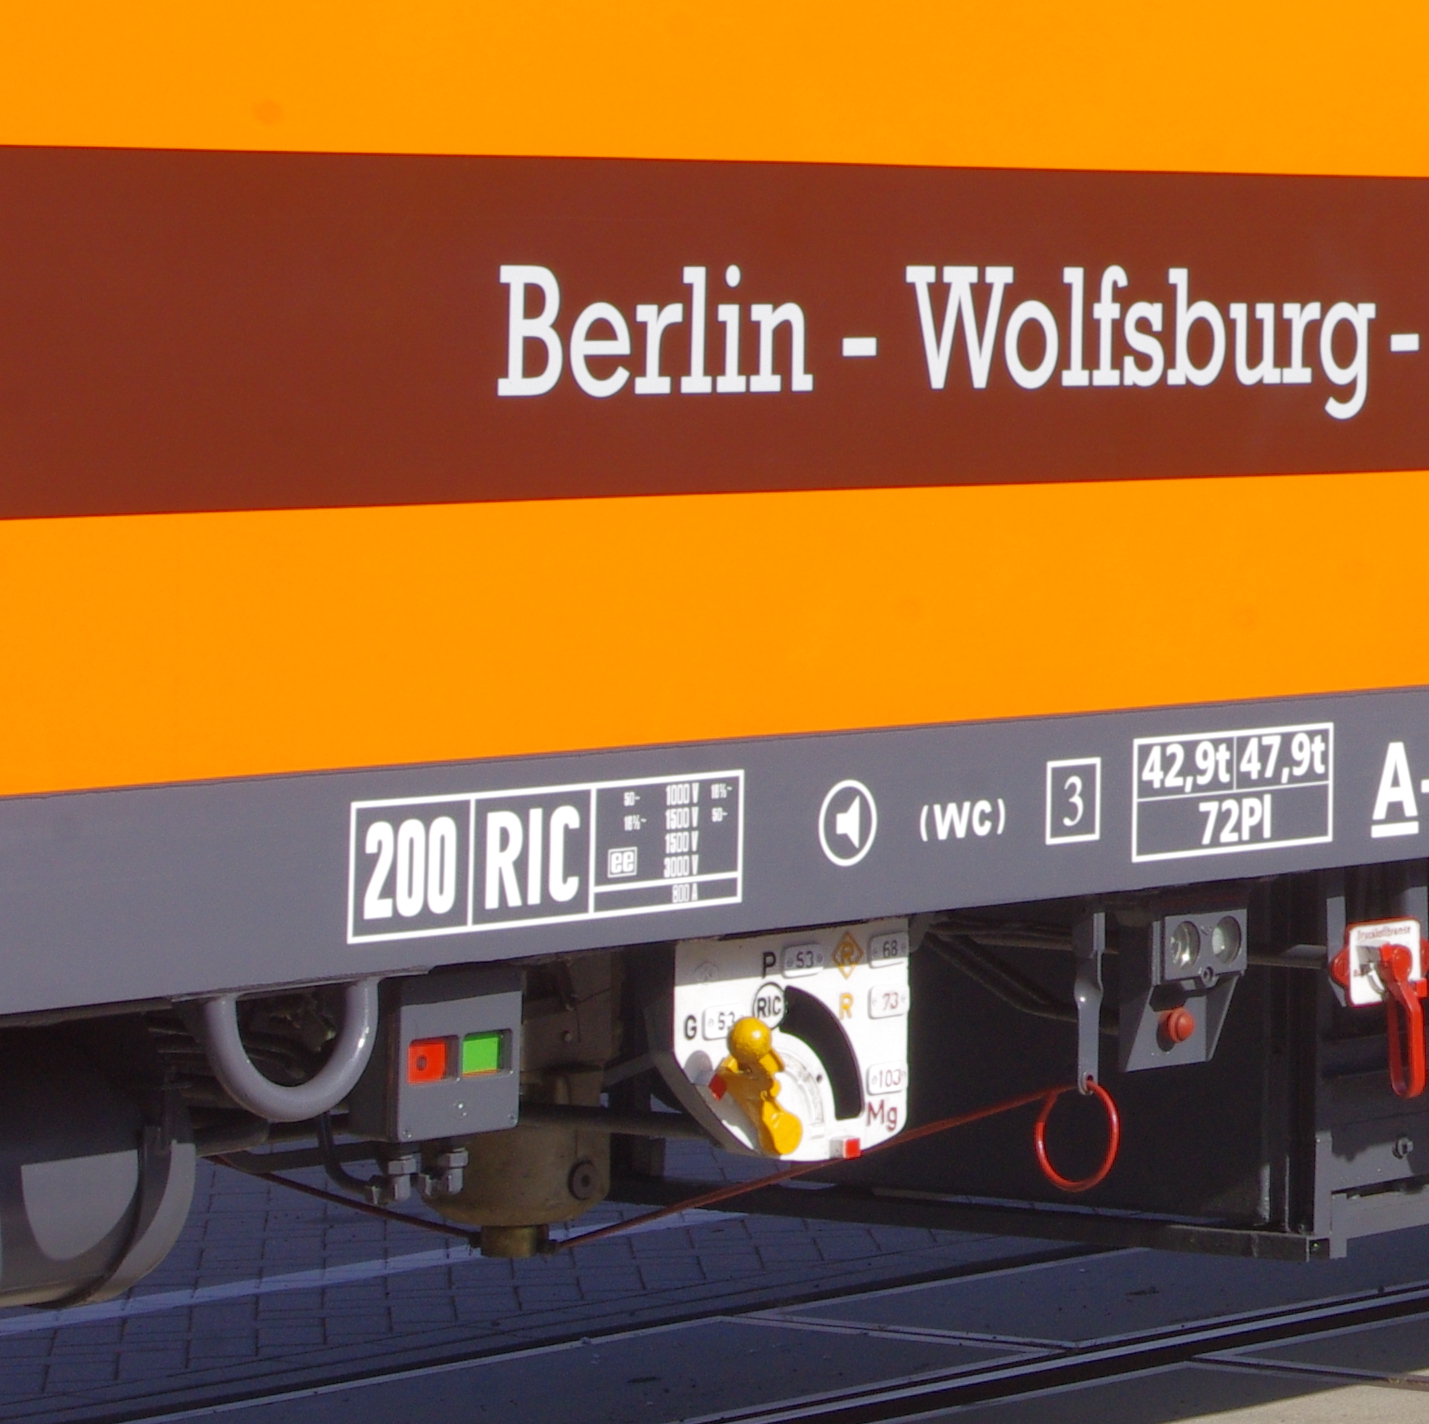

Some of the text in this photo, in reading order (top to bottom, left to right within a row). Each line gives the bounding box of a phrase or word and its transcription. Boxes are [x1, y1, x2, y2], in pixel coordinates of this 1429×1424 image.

[498, 265, 814, 398] Berlin
[906, 265, 1376, 420] Wolfsburg
[1141, 732, 1326, 794] 42,9t 47,9t
[665, 782, 690, 806] 1000
[1062, 775, 1084, 827] 3
[665, 806, 690, 830] 1500
[919, 798, 1006, 842] (WC)
[664, 830, 690, 854] 1500
[363, 815, 457, 921] 200
[484, 805, 581, 910] RIC
[610, 851, 635, 874] ee
[663, 855, 690, 879] 3000
[882, 940, 899, 959] 68
[762, 951, 814, 978] P 53
[757, 996, 782, 1018] RIC
[839, 992, 900, 1020] R 73
[684, 1015, 698, 1041] G
[877, 1068, 902, 1088] 103
[866, 1099, 898, 1132] Mg
